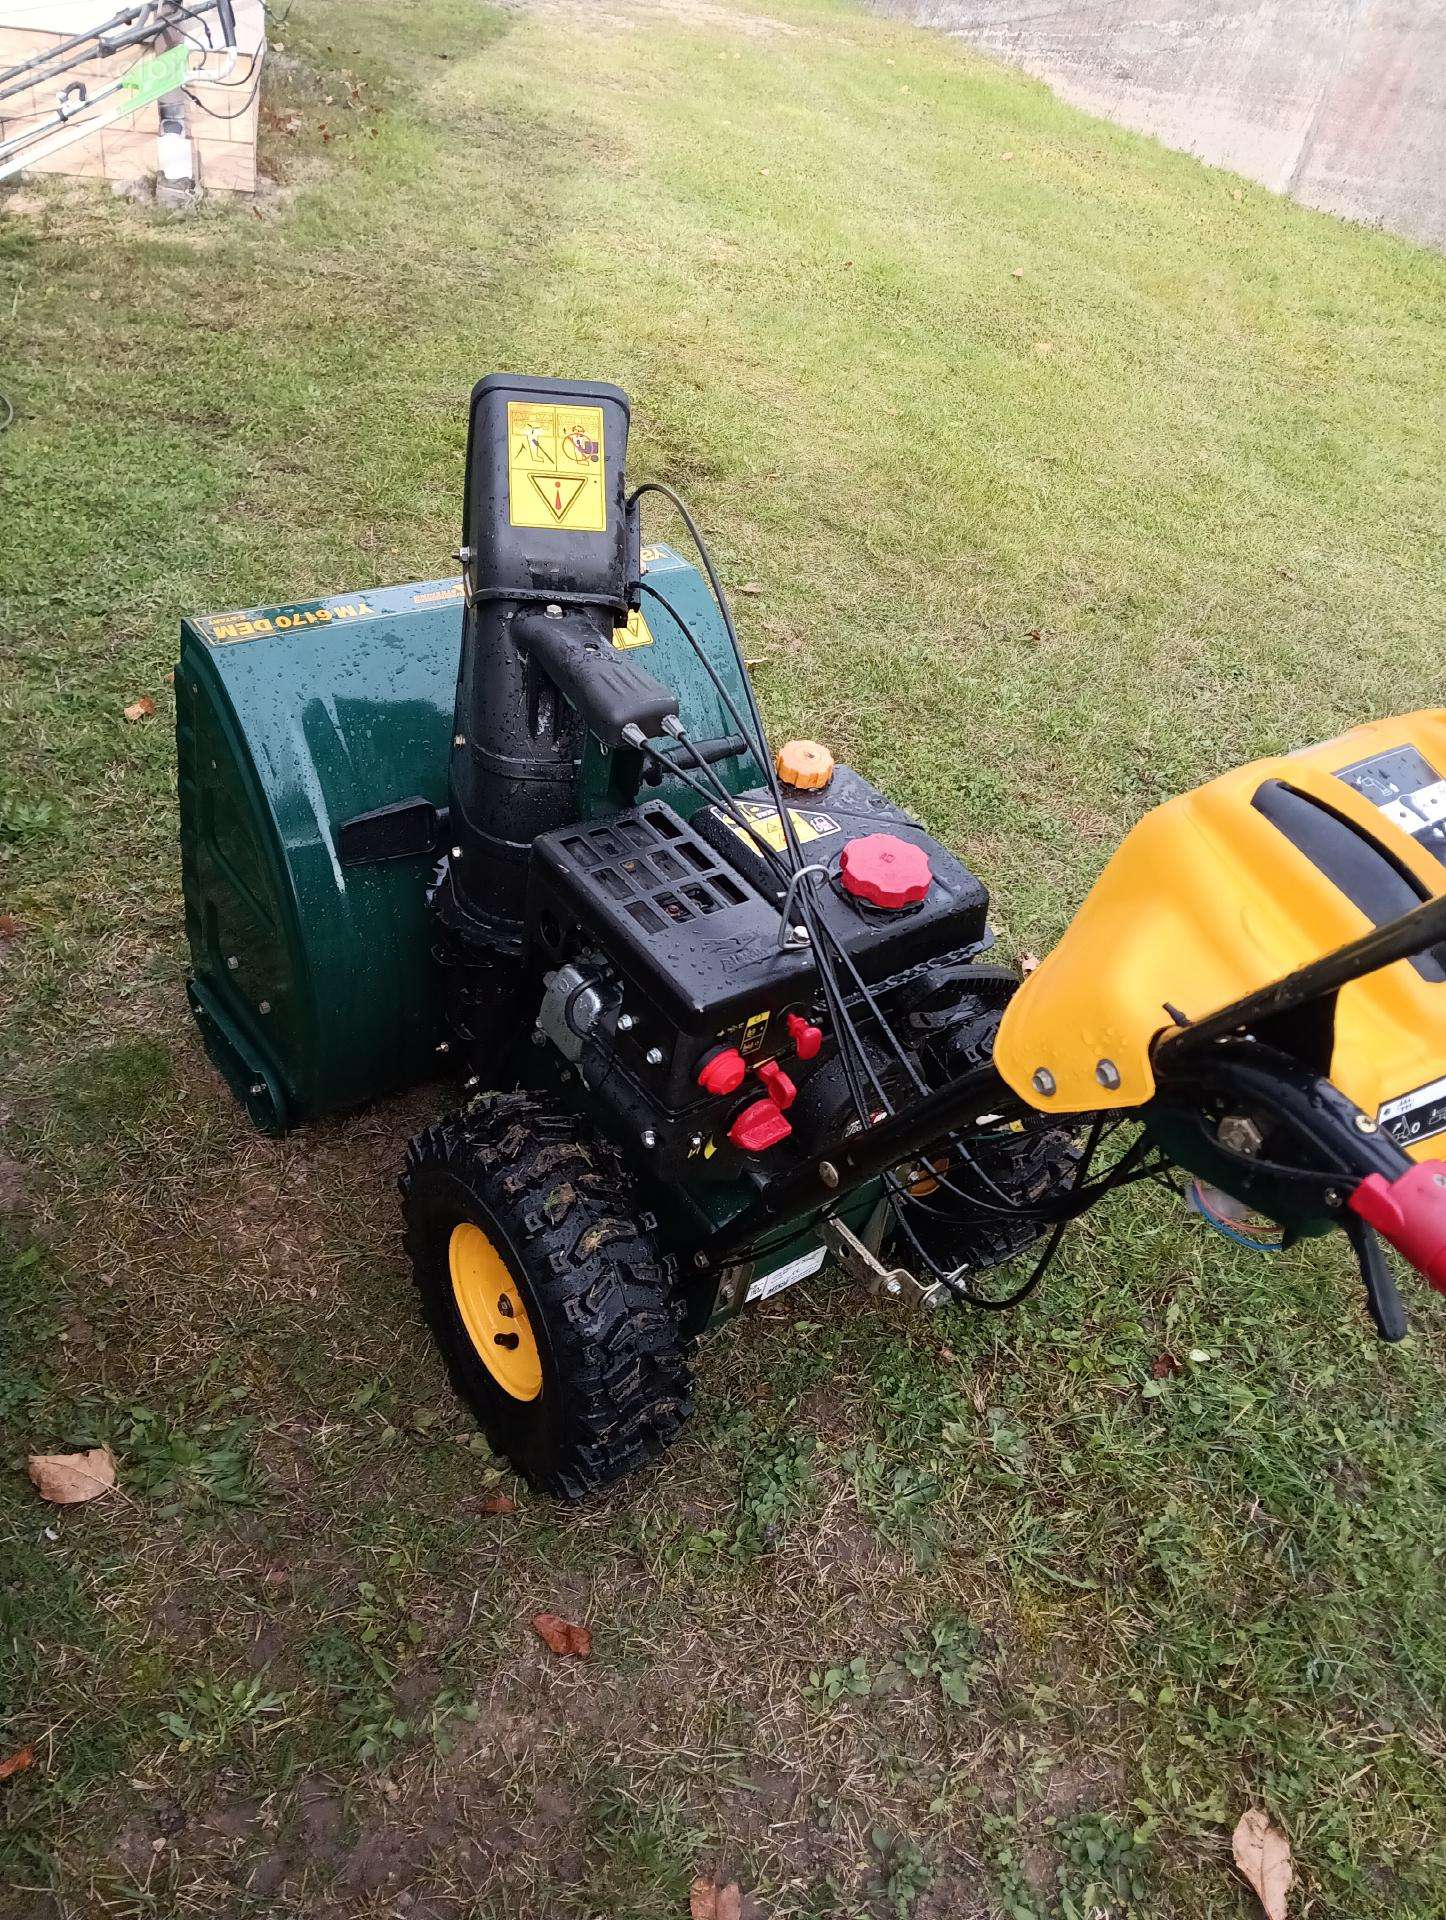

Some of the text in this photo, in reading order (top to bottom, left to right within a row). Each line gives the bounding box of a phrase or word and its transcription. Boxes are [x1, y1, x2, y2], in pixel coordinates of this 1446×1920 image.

[213, 603, 376, 640] YM 6170 DEM
